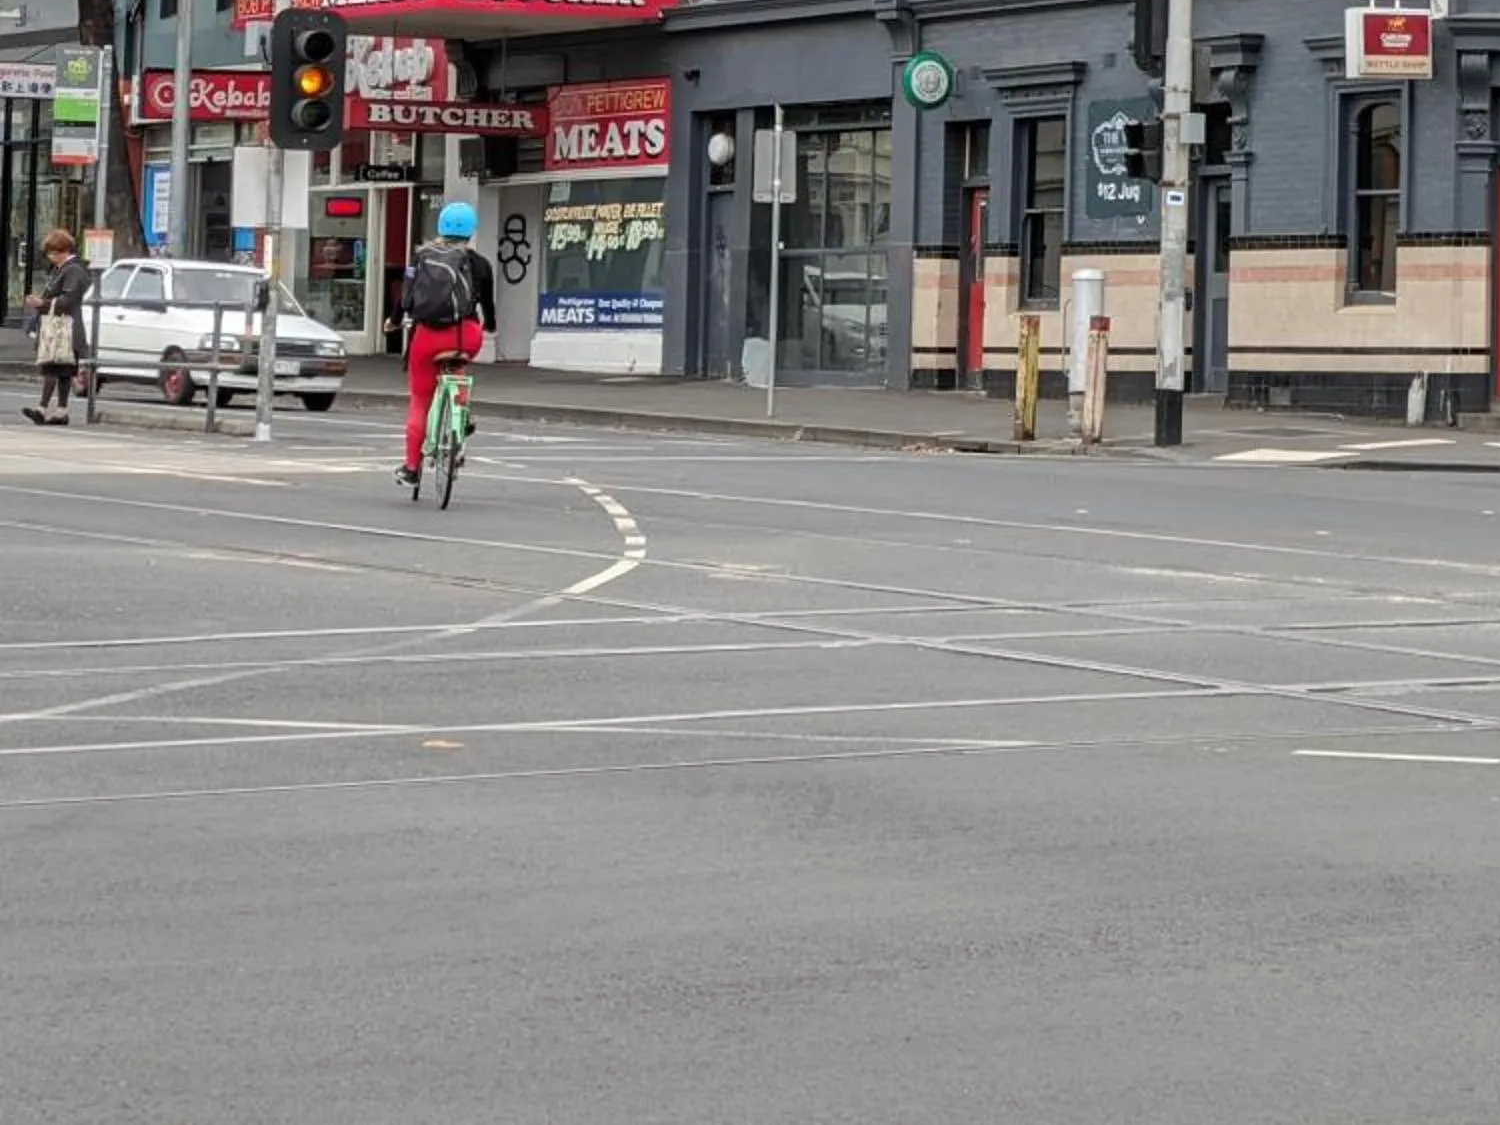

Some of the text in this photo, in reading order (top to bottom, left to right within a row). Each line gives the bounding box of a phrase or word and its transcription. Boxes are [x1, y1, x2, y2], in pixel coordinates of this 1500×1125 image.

[189, 78, 271, 114] Kebab
[586, 88, 667, 114] PETTIGREW
[368, 103, 535, 129] BUTCHER
[553, 118, 666, 161] MEATS
[540, 308, 596, 325] MEATS
